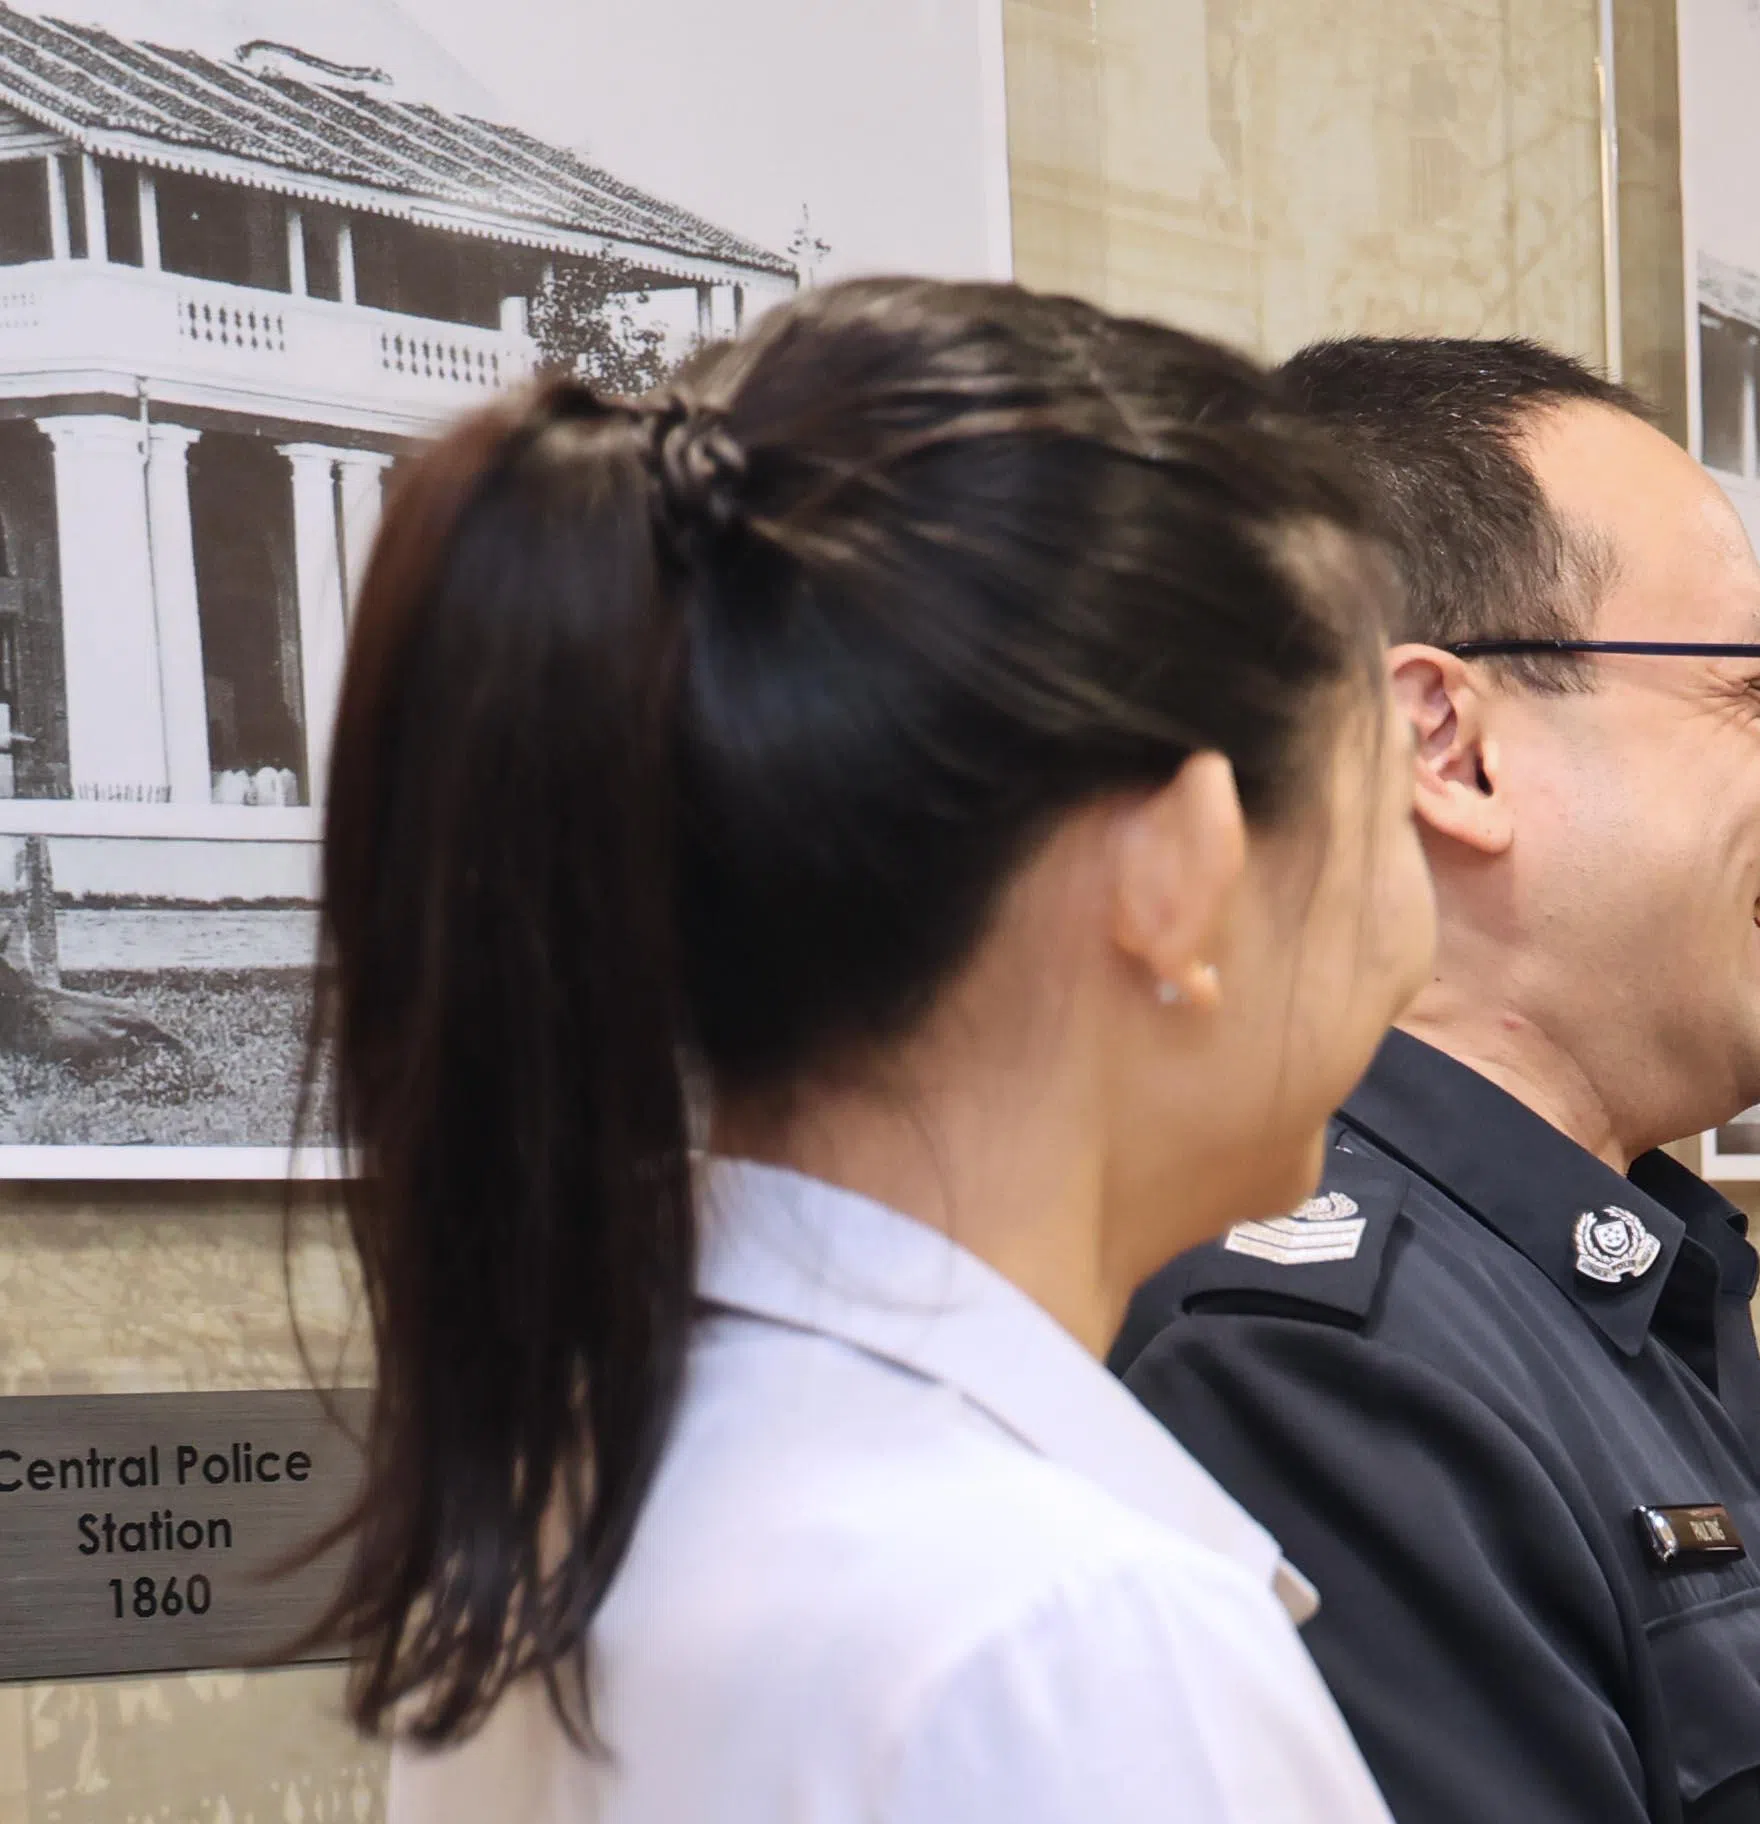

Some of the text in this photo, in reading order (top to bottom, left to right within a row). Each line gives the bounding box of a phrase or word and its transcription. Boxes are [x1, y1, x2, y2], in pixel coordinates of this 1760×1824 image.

[0, 1442, 313, 1492] Central Police
[78, 1510, 232, 1555] Station
[109, 1574, 211, 1618] 1860
